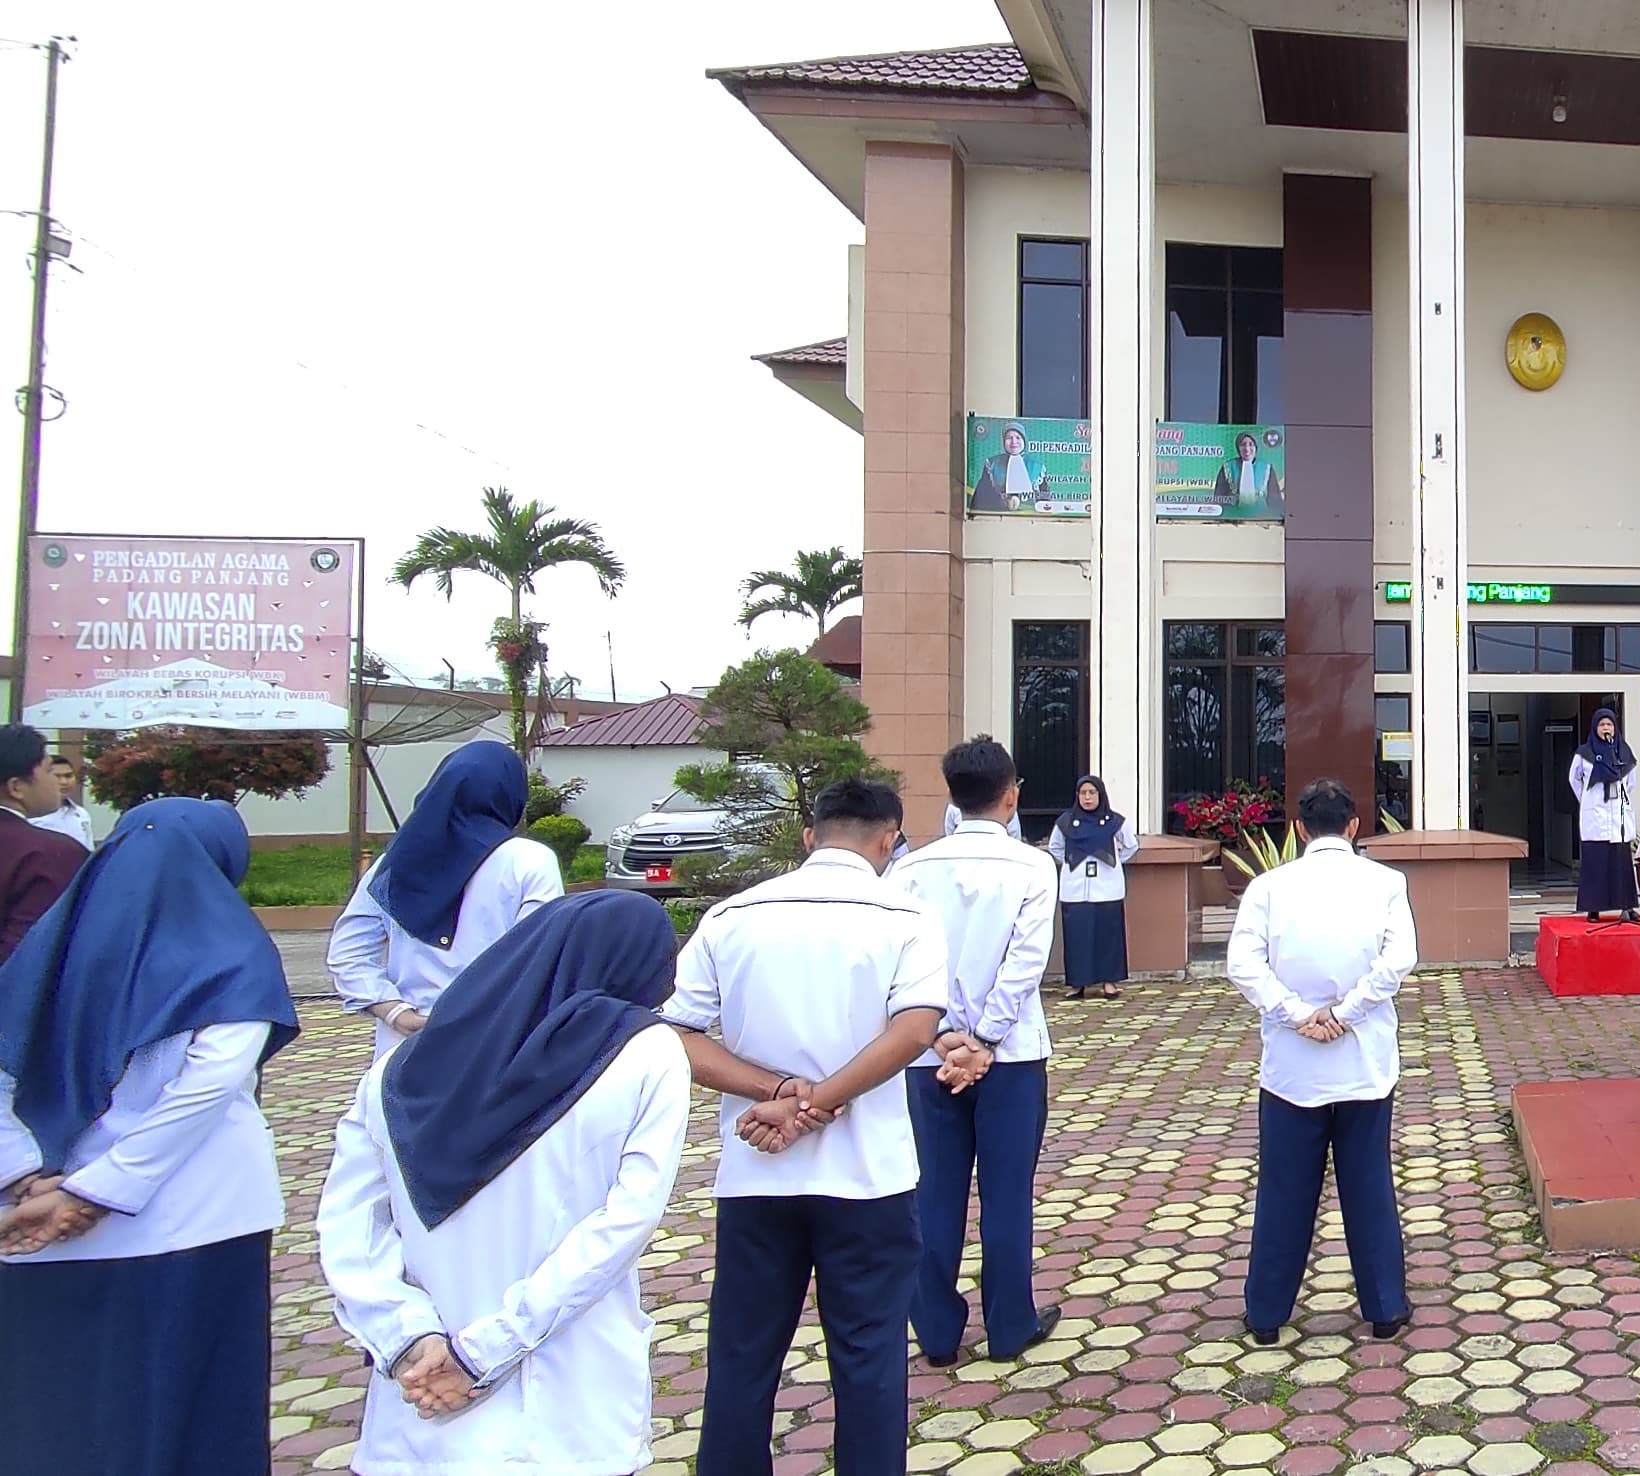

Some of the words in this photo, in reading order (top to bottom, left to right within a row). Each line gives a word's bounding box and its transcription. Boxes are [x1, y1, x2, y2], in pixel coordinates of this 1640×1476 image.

[1029, 441, 1040, 452] DI
[1180, 445, 1224, 457] PANJANG
[1156, 478, 1184, 486] RUPSI
[93, 550, 216, 569] PENGADILAN
[221, 552, 290, 571] AGAMA
[93, 569, 183, 584] PADANG
[191, 570, 289, 586] PANJANG
[1488, 583, 1551, 603] Panjang
[127, 591, 256, 621] KAWASAN
[76, 621, 148, 650] ZONA
[155, 622, 305, 653] INTEGRITAS
[95, 669, 150, 679] WILAYAH
[153, 669, 192, 679] BEBAS
[105, 689, 173, 699] BIROKRASI
[176, 690, 219, 700] BERSIH
[221, 690, 281, 700] MELAYANI
